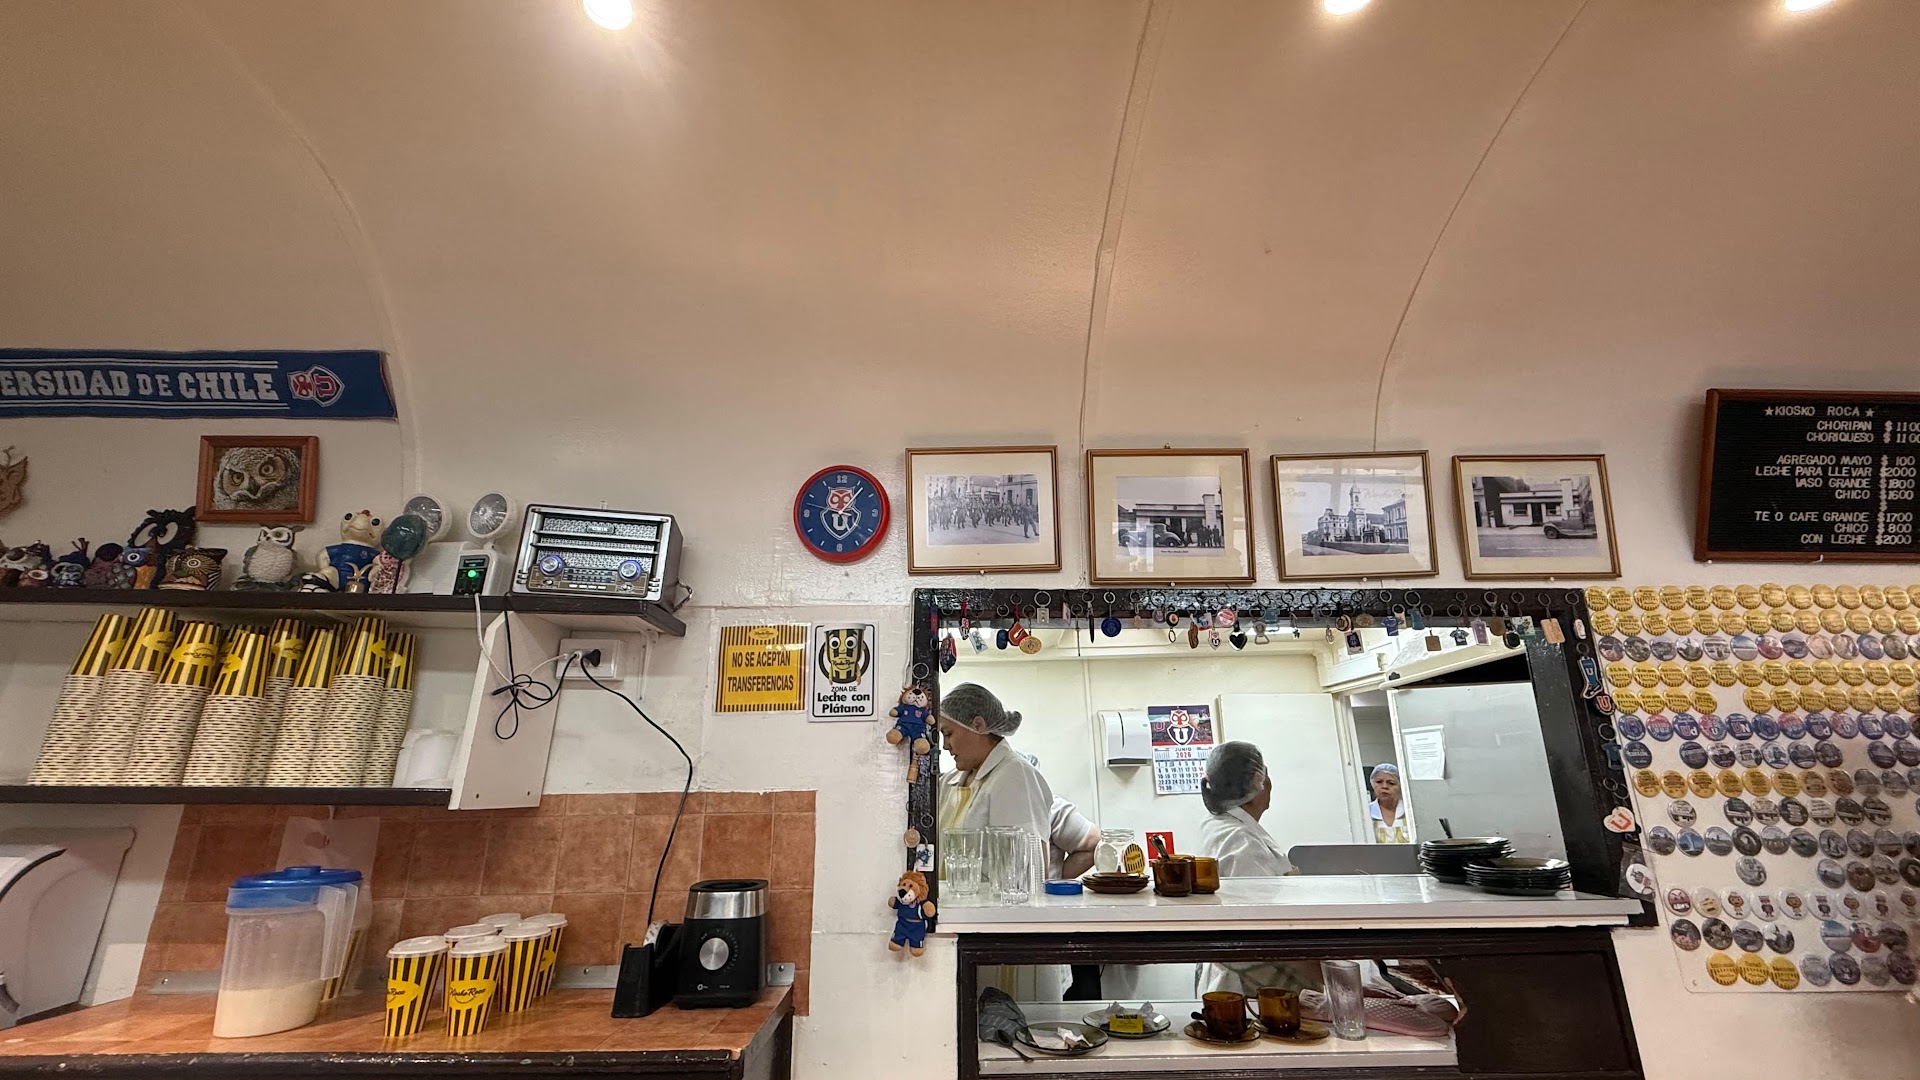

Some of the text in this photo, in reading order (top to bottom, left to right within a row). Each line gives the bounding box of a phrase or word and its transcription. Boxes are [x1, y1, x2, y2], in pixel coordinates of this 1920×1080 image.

[136, 373, 173, 396] DE
[177, 371, 279, 400] CHILE
[1775, 406, 1860, 416] KIOSKO ROCA
[1817, 420, 1872, 430] CHORIPAN
[1806, 432, 1874, 442] CHORIQUESO
[1776, 455, 1836, 465] AGREGADO
[1840, 455, 1873, 465] MAYO
[1895, 456, 1915, 466] 100
[1755, 466, 1791, 476] LECHE
[1795, 466, 1823, 476] PARA
[1828, 466, 1873, 477] LLEVAR
[836, 475, 848, 483] 12
[1795, 478, 1823, 488] VASO
[1828, 478, 1871, 488] GRANDE
[1835, 489, 1870, 499] CHICO
[831, 514, 849, 530] U
[1754, 511, 1770, 521] TE
[1774, 512, 1784, 521] O
[1789, 512, 1819, 522] CAFE
[1822, 512, 1869, 522] GRANDE
[1834, 523, 1869, 533] CHICO
[1888, 524, 1912, 533] 800
[1800, 533, 1823, 544] CON
[1830, 534, 1867, 544] LECHE
[732, 651, 790, 667] NO SE ACEPTAN
[728, 675, 793, 692] TRANSFERENCIAS
[817, 692, 870, 702] Leche con
[822, 703, 865, 714] Plátano
[1596, 696, 1611, 711] U
[1173, 728, 1189, 743] U
